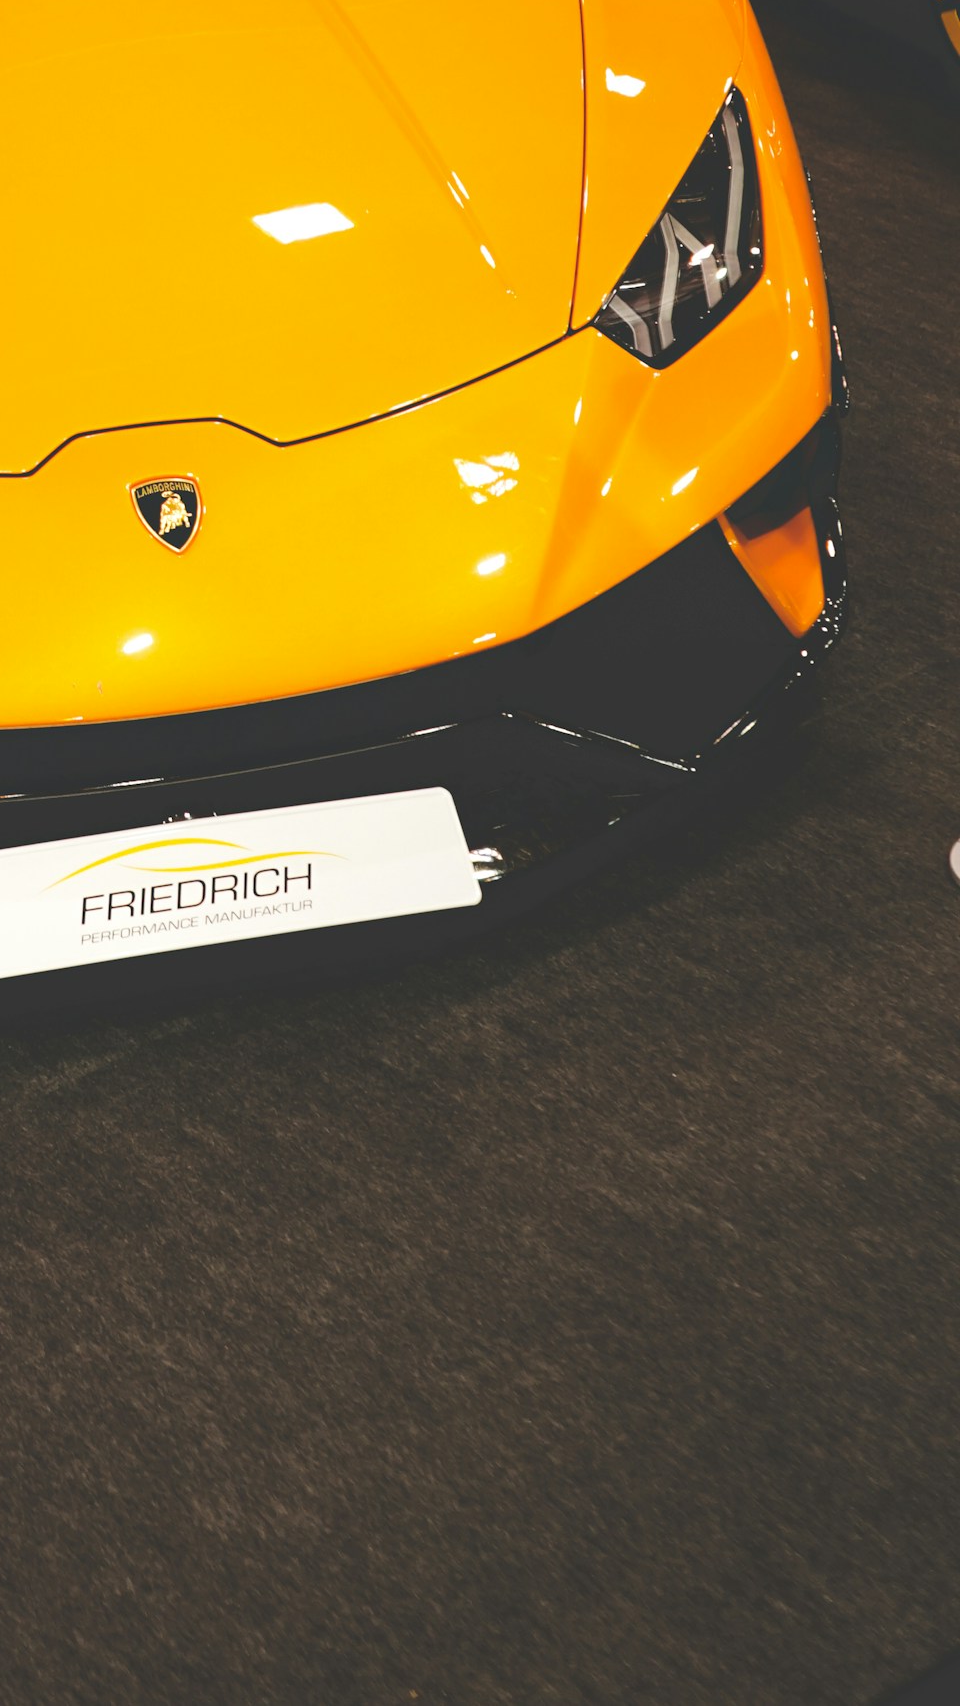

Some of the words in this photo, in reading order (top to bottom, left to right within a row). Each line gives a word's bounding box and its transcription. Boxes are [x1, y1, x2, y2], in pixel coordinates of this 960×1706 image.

[136, 482, 194, 498] LAMBORGHINI
[81, 863, 312, 926] FRIEDRICH
[81, 915, 199, 945] PERFORMANCE
[205, 899, 313, 925] MANUFAKTUR
